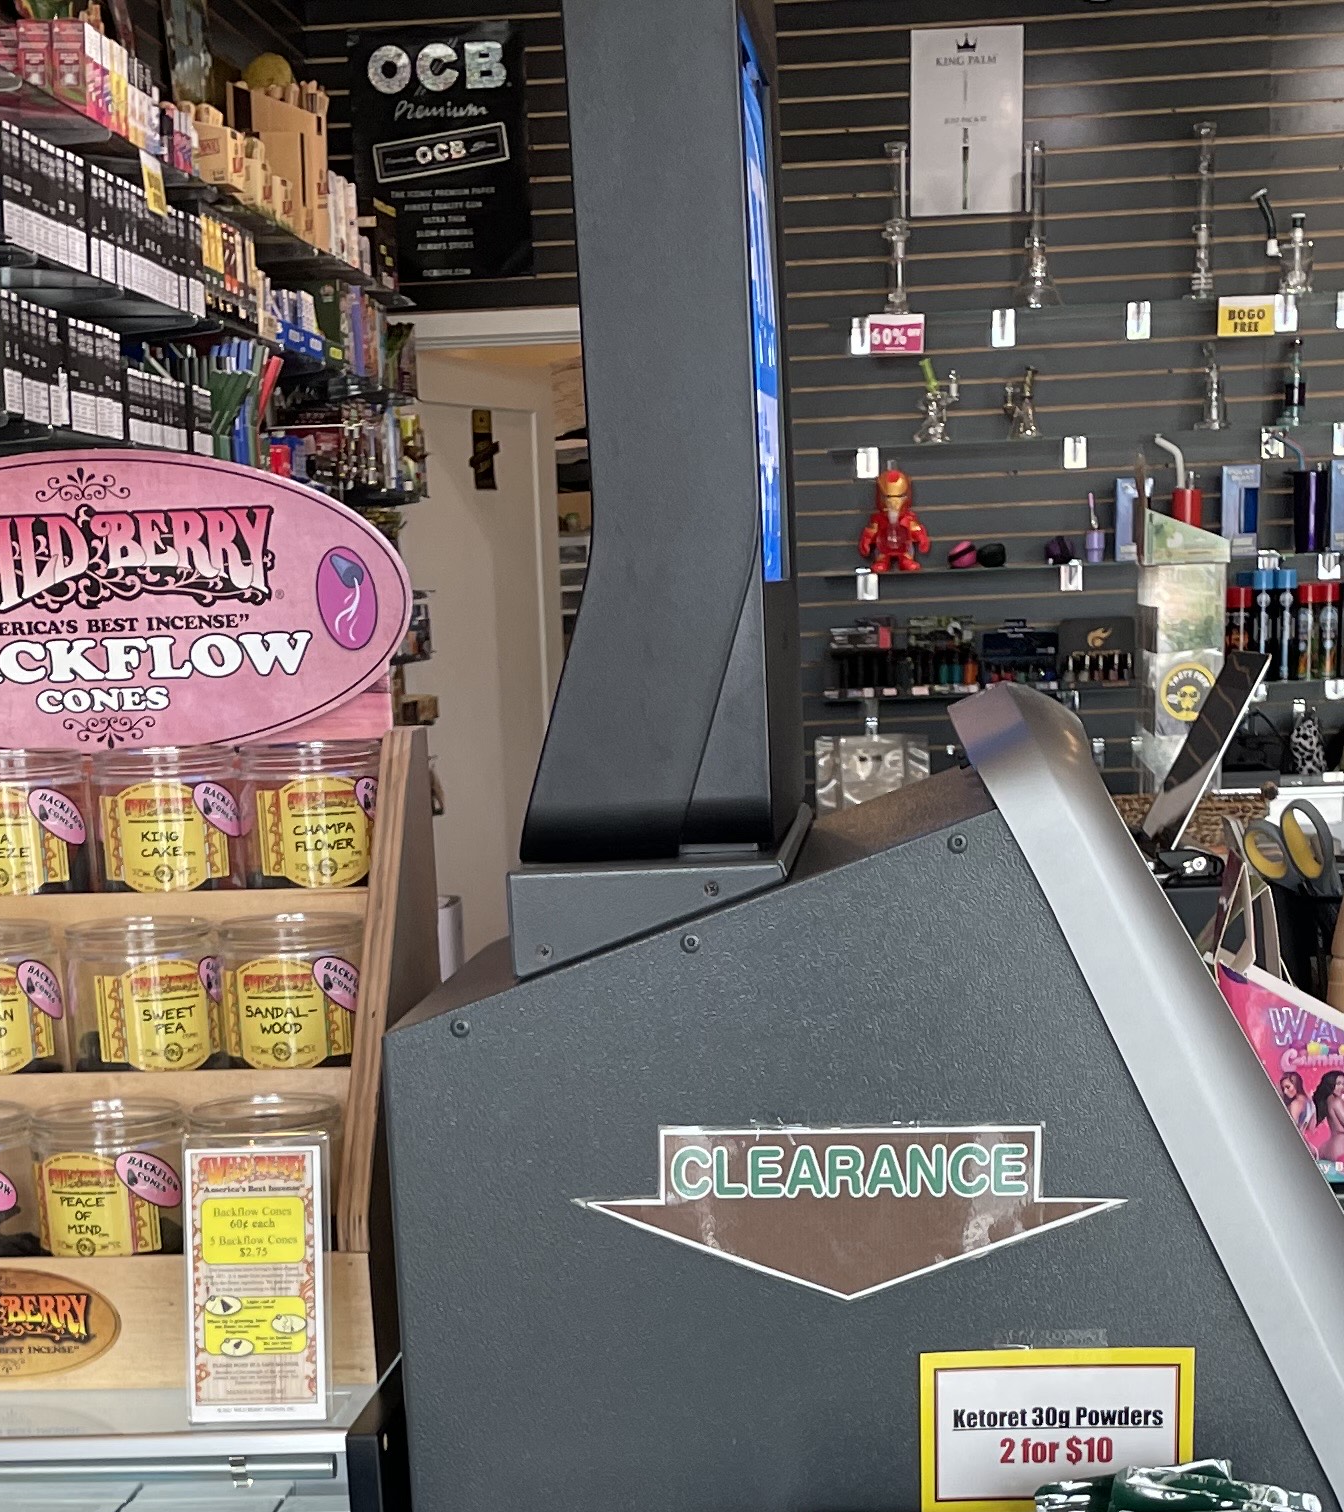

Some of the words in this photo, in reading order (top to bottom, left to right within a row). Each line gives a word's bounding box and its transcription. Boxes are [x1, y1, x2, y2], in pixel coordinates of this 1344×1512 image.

[368, 41, 507, 94] OCB
[936, 56, 965, 66] KING
[394, 100, 489, 121] Premium
[415, 140, 467, 164] OCB
[1228, 308, 1266, 323] BOGO
[871, 324, 907, 347] 60%
[1233, 321, 1260, 334] FREE
[90, 505, 273, 606] BERRY
[87, 615, 140, 634] BEST
[146, 612, 251, 632] INCENSE"
[36, 687, 170, 714] CONES
[140, 829, 180, 844] KING
[292, 821, 356, 838] CHAMPA
[140, 844, 182, 859] CAKE
[294, 837, 356, 853] FLOWER
[142, 1004, 196, 1021] SWEET
[245, 1004, 318, 1021] SANDAL-
[154, 1020, 186, 1036] PEA
[259, 1020, 303, 1036] WOOD
[670, 1145, 1029, 1200] CLEARANCE
[59, 1195, 105, 1209] PEACE
[74, 1209, 92, 1222] OF
[252, 1218, 275, 1228] each
[67, 1222, 103, 1237] MIND
[239, 1246, 268, 1257] $2.75
[2, 1289, 96, 1342] BERRY
[953, 1405, 1027, 1430] Ketoret
[1031, 1407, 1071, 1432] 30g
[1075, 1405, 1164, 1428] Powders
[999, 1437, 1016, 1465] 2
[1021, 1436, 1060, 1465] for
[1065, 1435, 1113, 1466] $10
